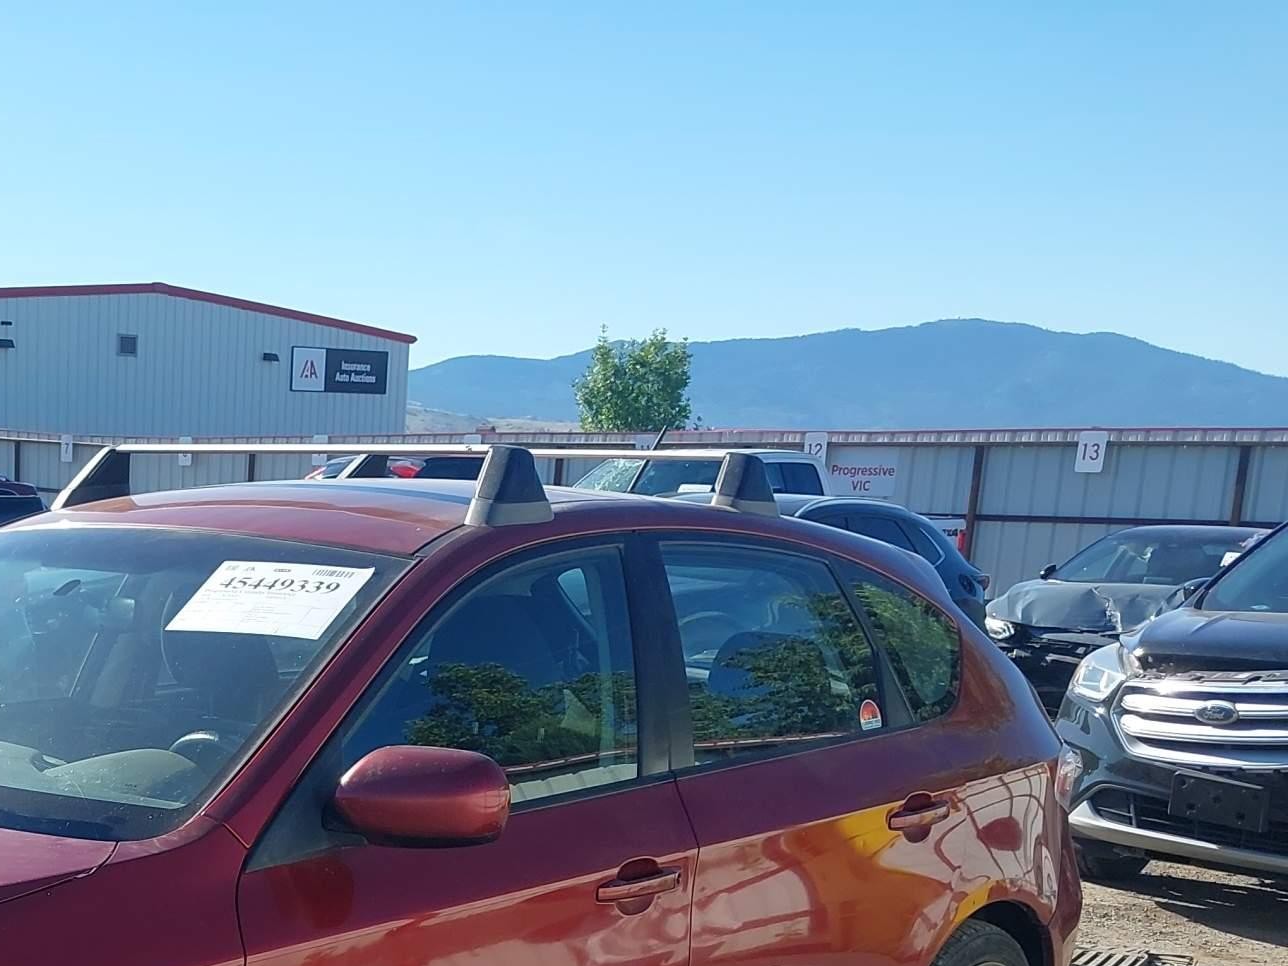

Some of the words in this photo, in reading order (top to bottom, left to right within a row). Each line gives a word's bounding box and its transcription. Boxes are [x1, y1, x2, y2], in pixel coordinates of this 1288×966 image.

[341, 361, 371, 372] Insurance
[335, 372, 349, 382] Auto
[350, 373, 376, 384] Auctions
[64, 442, 70, 455] 7
[1082, 442, 1100, 461] 13
[831, 464, 895, 477] Progressive
[851, 480, 871, 491] VIC
[220, 576, 341, 594] 45449339
